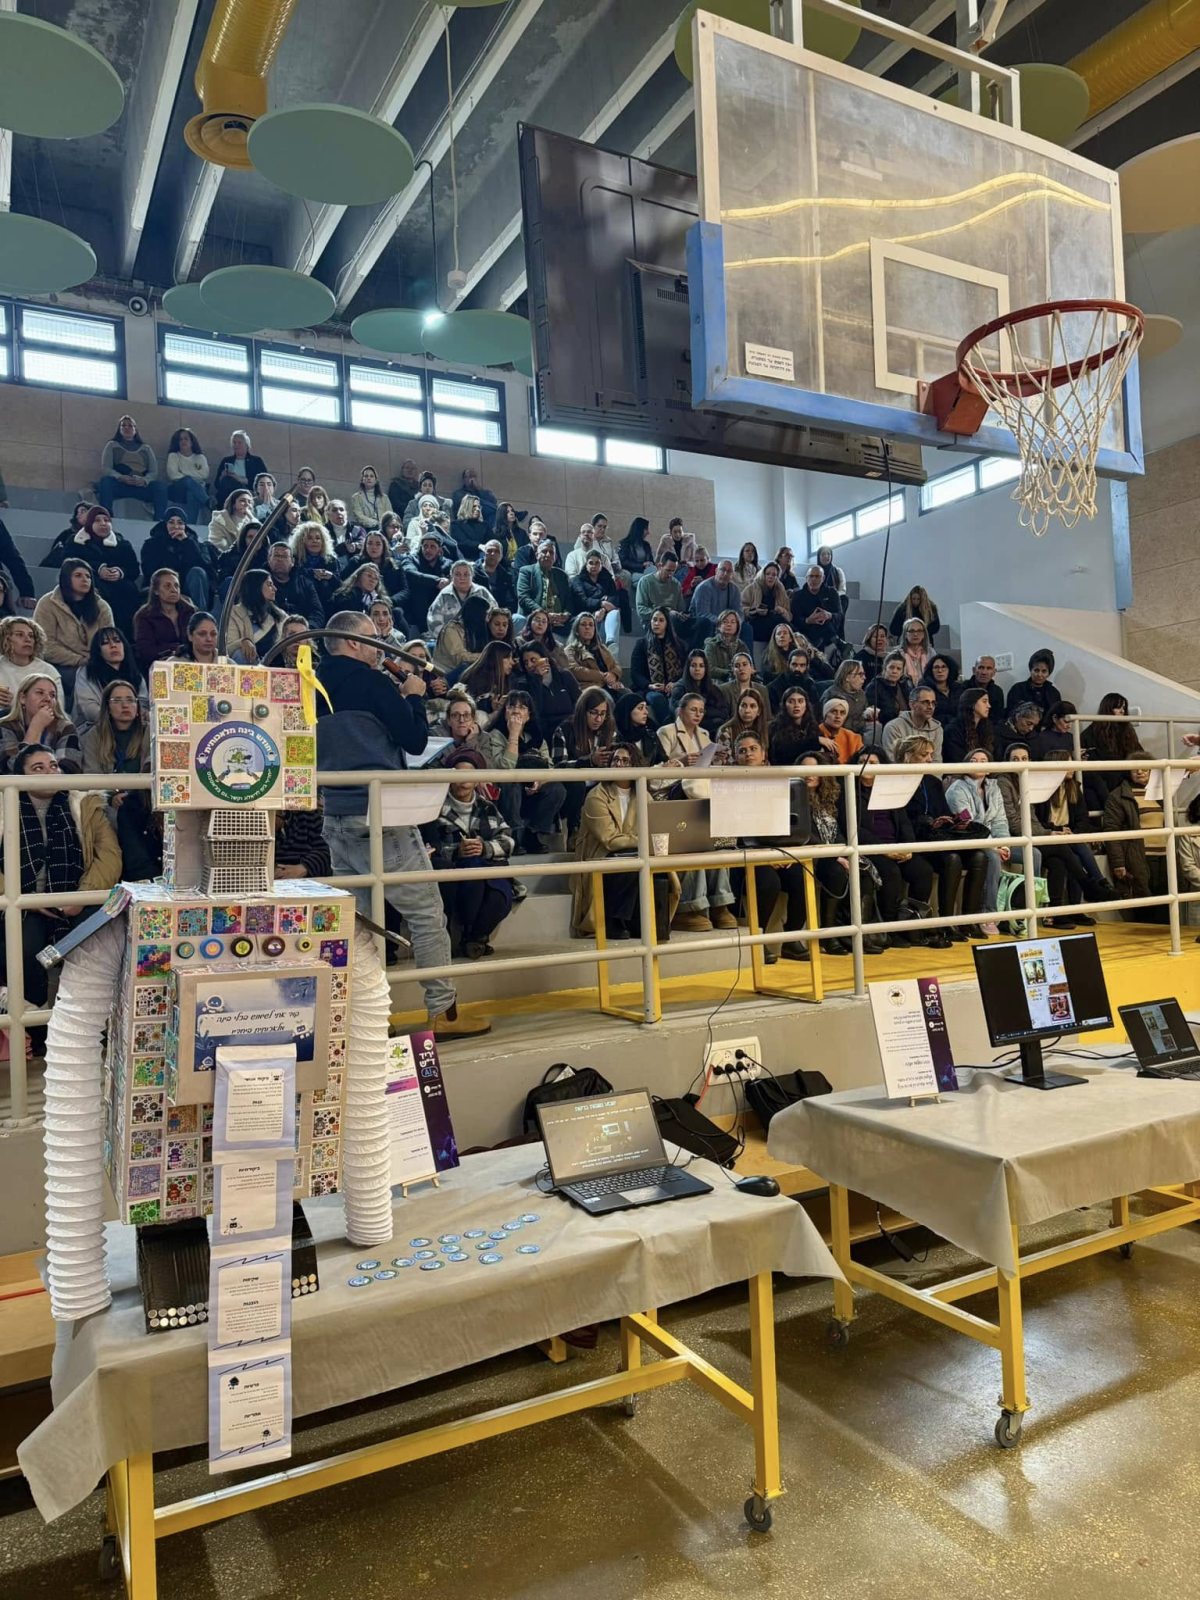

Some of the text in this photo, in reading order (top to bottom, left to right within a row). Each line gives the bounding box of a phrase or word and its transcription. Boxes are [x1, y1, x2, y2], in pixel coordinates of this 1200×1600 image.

[204, 727, 273, 754] חודש בינה מלאכותית
[234, 1012, 248, 1022] בכלי
[250, 1010, 275, 1020] לשימוש
[254, 1022, 285, 1034] מלאכותית
